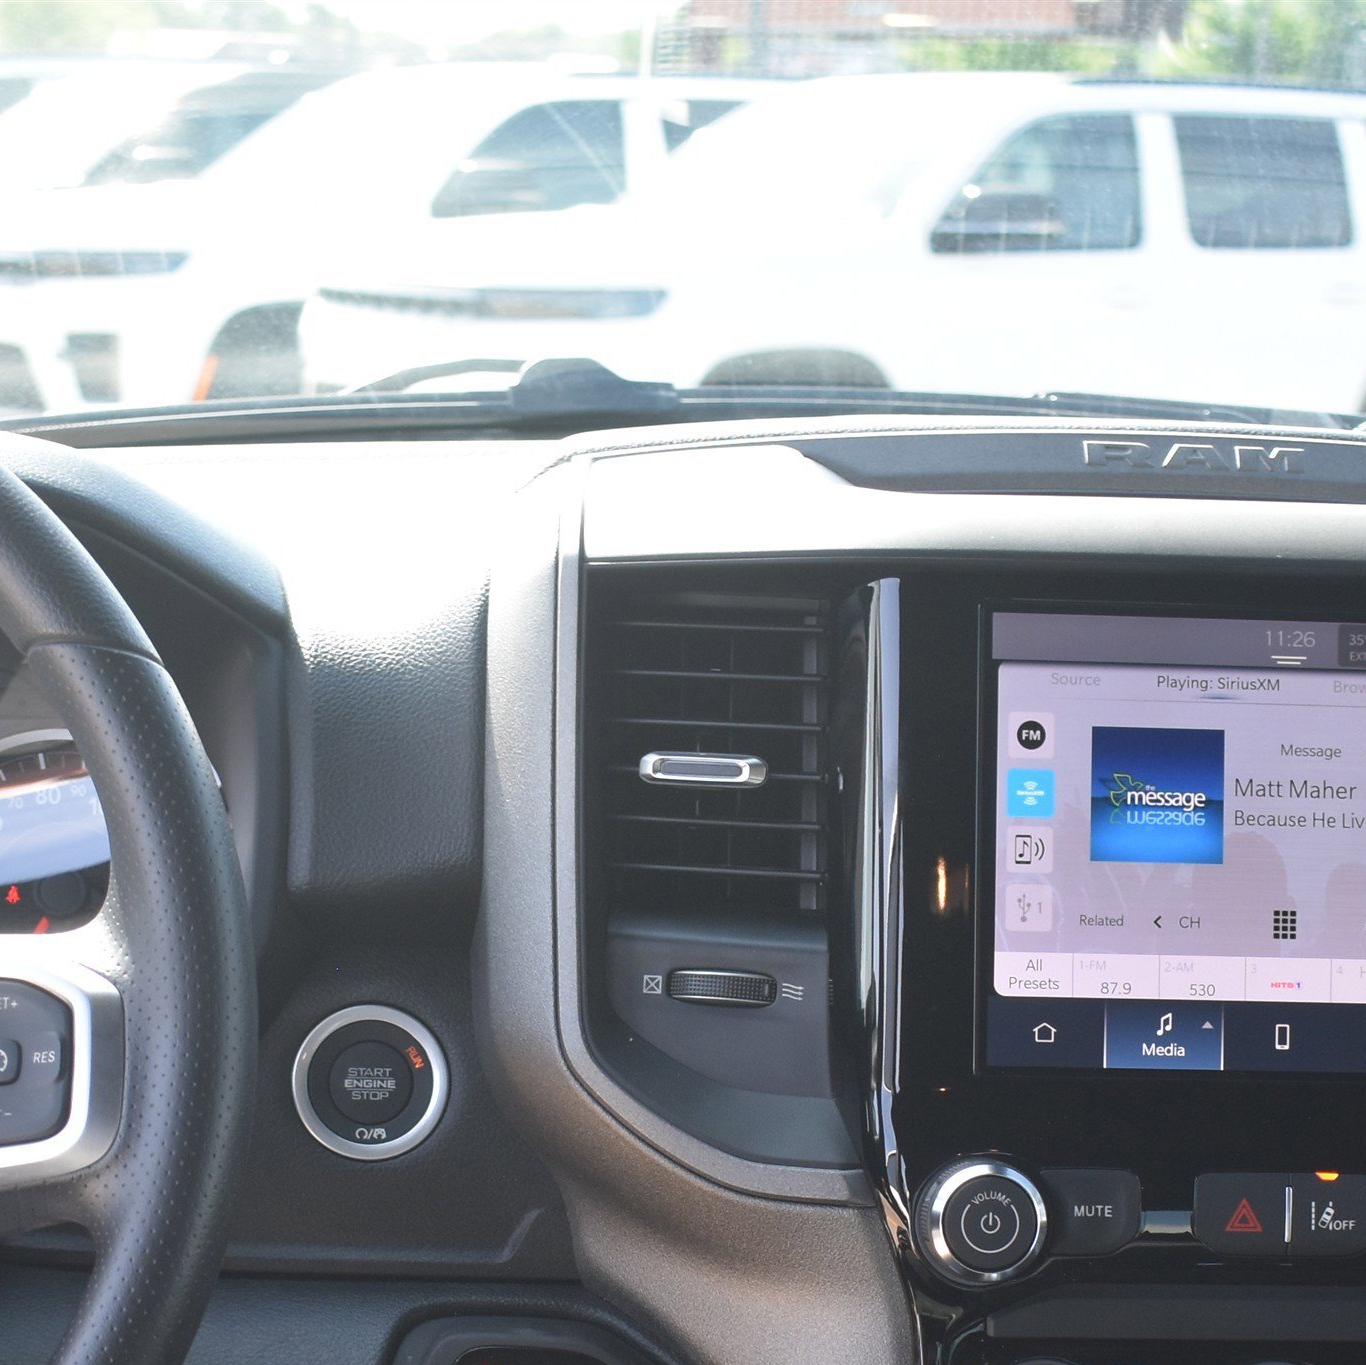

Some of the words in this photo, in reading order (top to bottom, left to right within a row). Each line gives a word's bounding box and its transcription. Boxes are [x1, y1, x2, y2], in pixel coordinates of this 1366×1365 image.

[1083, 440, 1305, 473] RAM
[1265, 630, 1315, 648] 11:26
[1051, 672, 1102, 686] Source
[1157, 675, 1213, 692] Playing:
[1217, 677, 1281, 692] SiriusXM
[1021, 730, 1041, 741] FM
[1280, 744, 1342, 761] Message
[36, 786, 61, 805] 80
[1235, 778, 1283, 799] Matt
[1289, 780, 1358, 800] Maher
[1127, 790, 1206, 811] message
[1235, 810, 1307, 828] Because
[1312, 813, 1336, 829] He
[1079, 914, 1124, 927] Related
[1179, 917, 1201, 929] CH
[1025, 959, 1043, 972] All
[1079, 961, 1107, 971] 1-FM
[1164, 962, 1194, 973] 2-AM
[1008, 976, 1060, 990] Presets
[1100, 982, 1132, 995] 87.9
[1189, 984, 1216, 997] 530
[1142, 1043, 1186, 1057] Media
[33, 1051, 56, 1065] RES
[348, 1067, 393, 1077] START
[344, 1079, 397, 1089] ENGINE
[351, 1091, 389, 1100] STOP
[971, 1190, 1012, 1207] VOLUME
[1073, 1205, 1113, 1218] MUTE
[1333, 1219, 1356, 1231] OFF
